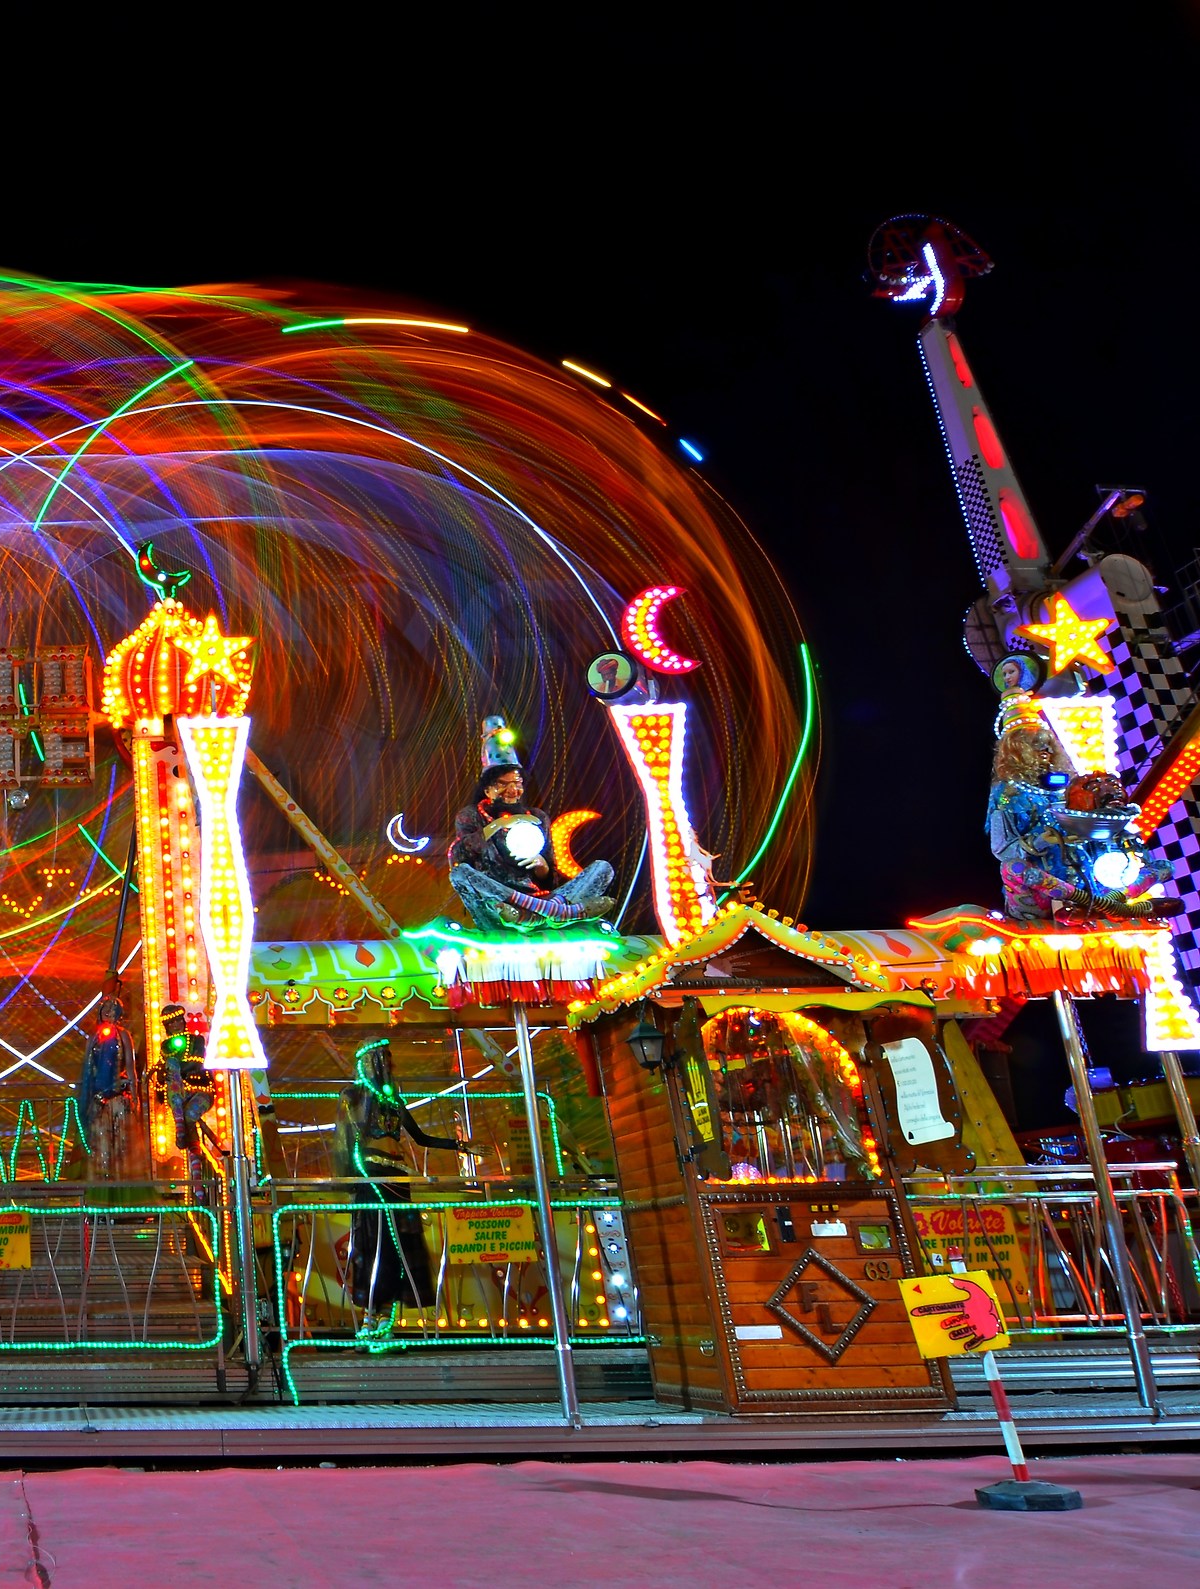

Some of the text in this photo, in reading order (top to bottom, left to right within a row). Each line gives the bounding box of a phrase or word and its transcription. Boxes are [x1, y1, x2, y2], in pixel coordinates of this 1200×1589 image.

[468, 1220, 511, 1229] POSSONO
[475, 1231, 507, 1241] SALIRE
[974, 1235, 1015, 1247] GRANDI
[450, 1241, 535, 1253] GRANDI E PICCINI
[935, 1255, 942, 1264] 4
[976, 1252, 988, 1262] IN
[863, 1260, 892, 1281] 69
[797, 1282, 844, 1335] F L
